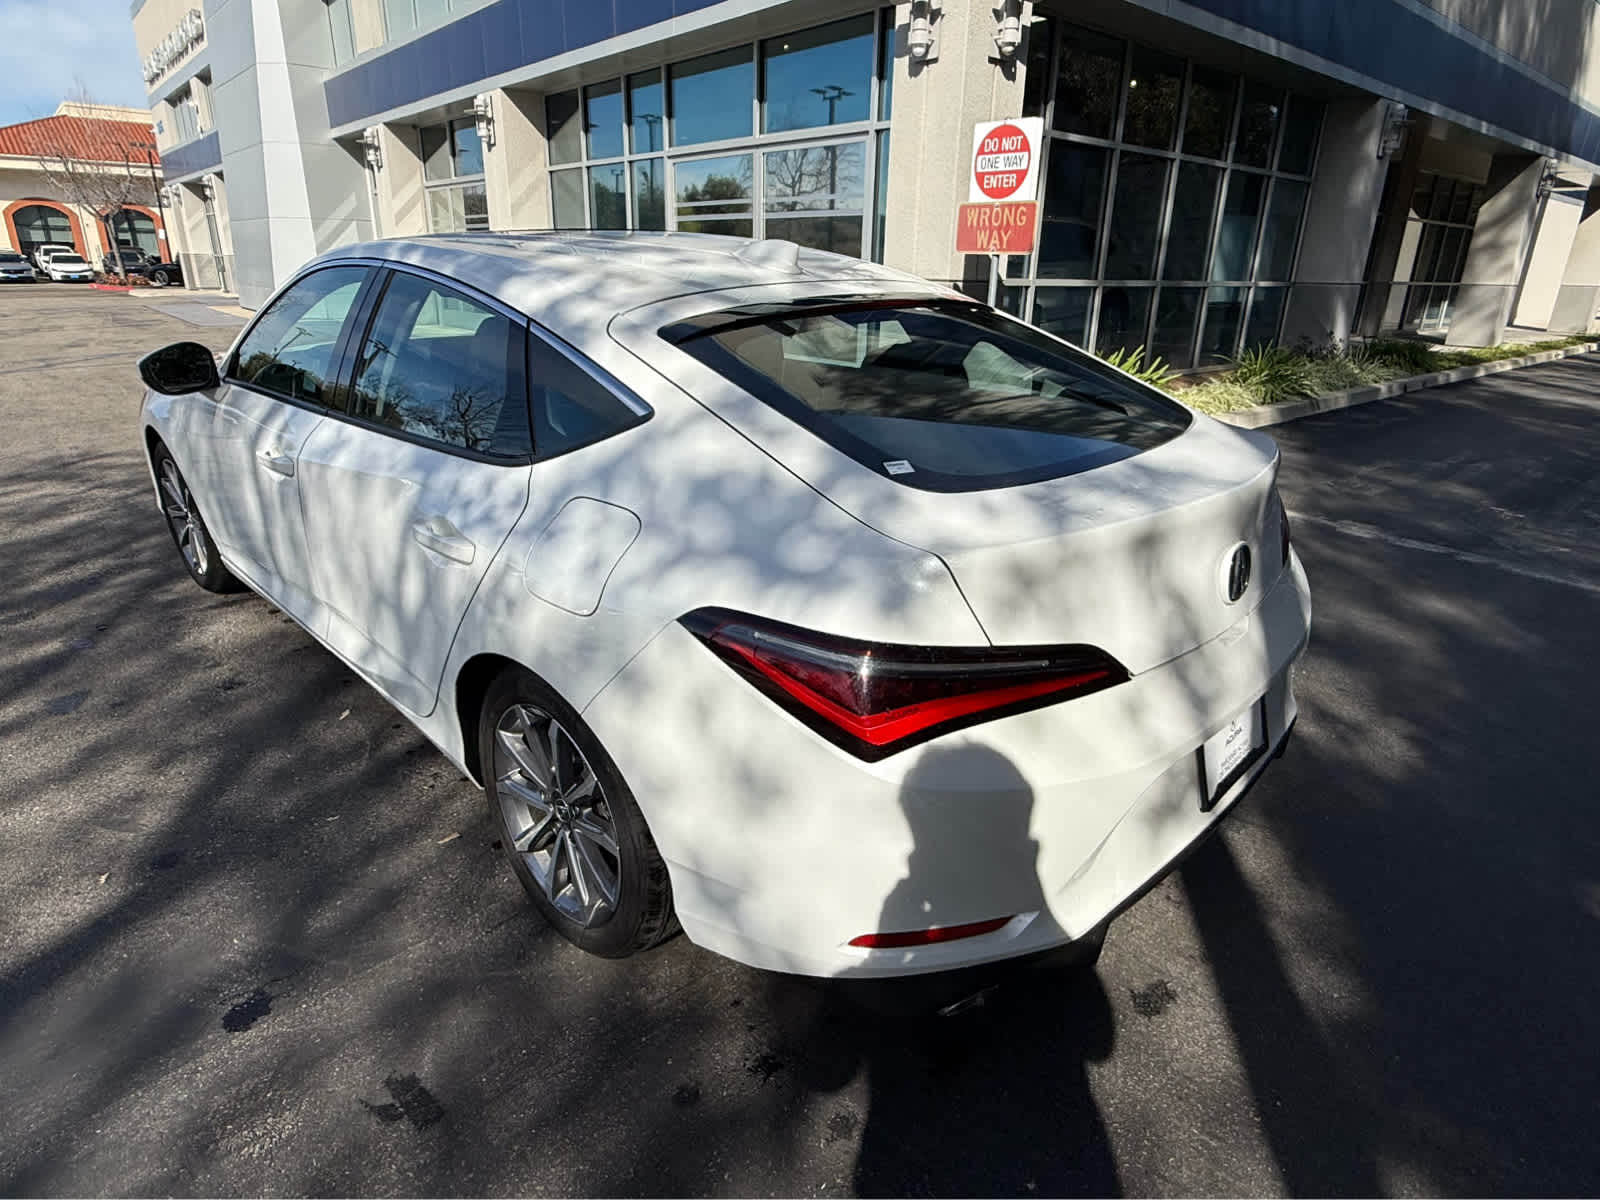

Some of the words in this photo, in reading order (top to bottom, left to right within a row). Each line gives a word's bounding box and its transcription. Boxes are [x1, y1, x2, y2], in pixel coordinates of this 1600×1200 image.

[984, 138, 998, 152] DO
[1001, 136, 1023, 151] NOT
[980, 155, 1000, 170] ONE
[1003, 154, 1025, 168] WAY
[983, 174, 1016, 189] ENTER
[967, 207, 1026, 226] WRONG
[976, 229, 1012, 249] WAY
